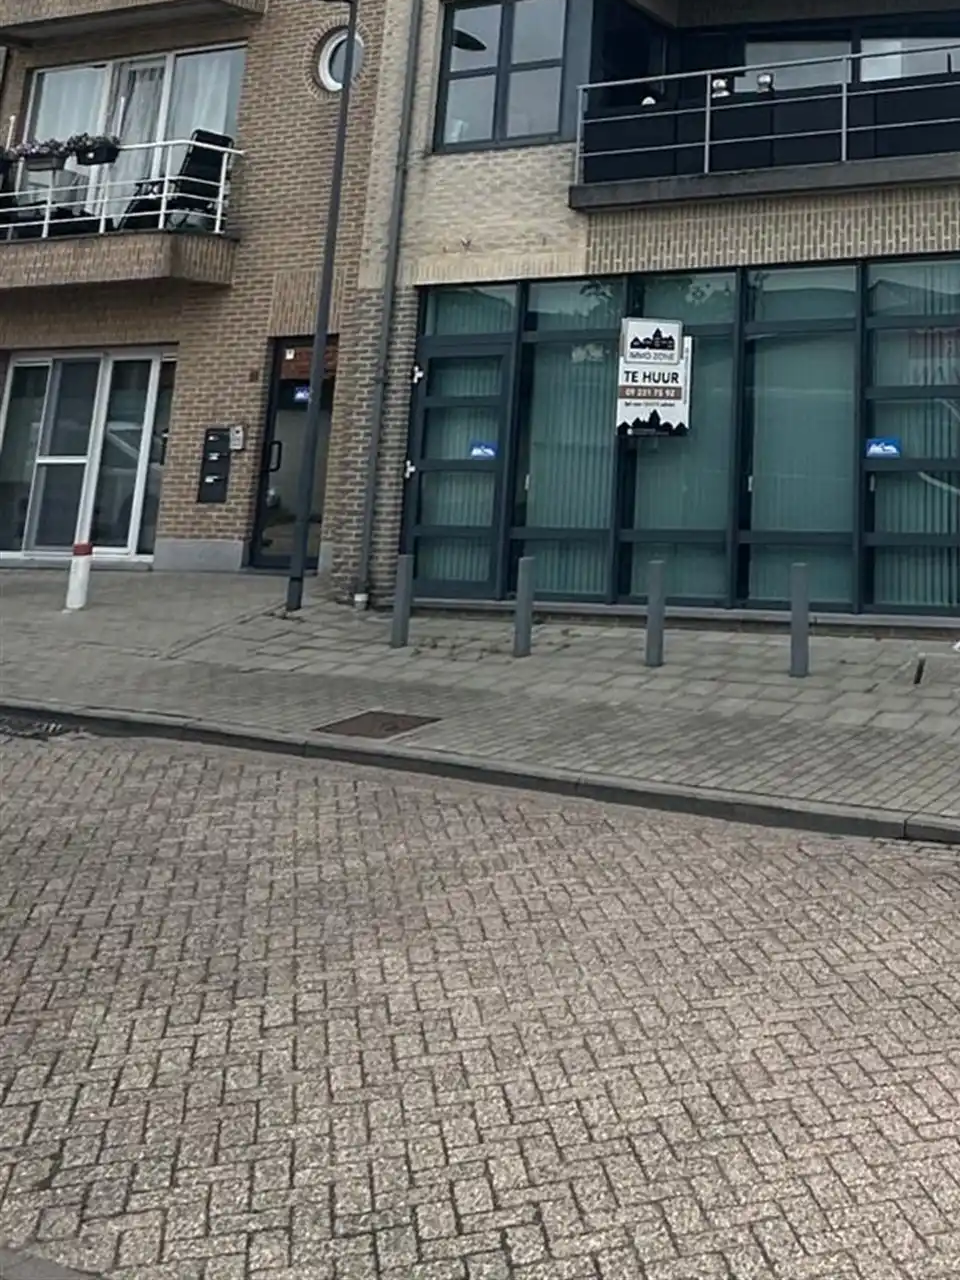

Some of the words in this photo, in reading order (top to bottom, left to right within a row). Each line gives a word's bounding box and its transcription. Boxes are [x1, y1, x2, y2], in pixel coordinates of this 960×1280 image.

[653, 352, 675, 361] ZONE
[624, 370, 639, 383] TE
[642, 371, 679, 384] HUUR
